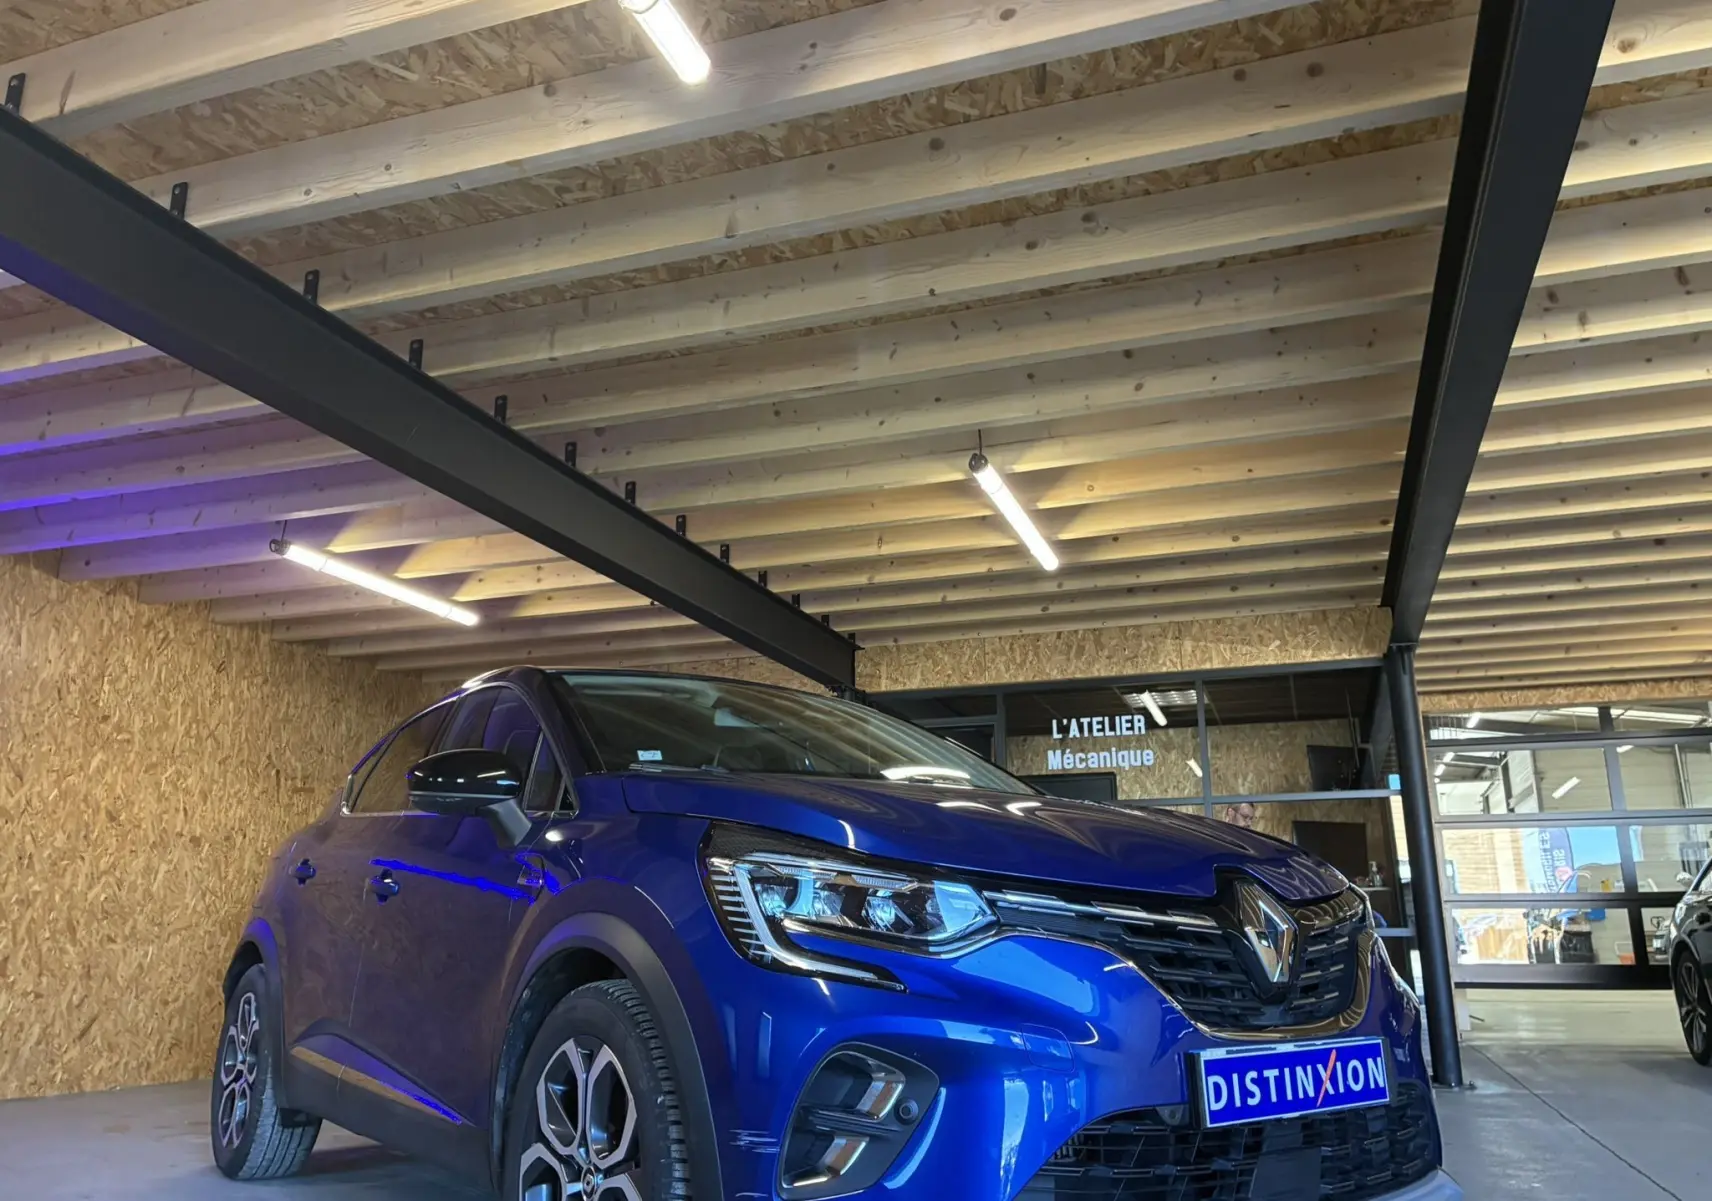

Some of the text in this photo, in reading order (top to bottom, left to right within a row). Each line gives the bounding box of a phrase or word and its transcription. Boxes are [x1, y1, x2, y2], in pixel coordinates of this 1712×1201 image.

[1052, 714, 1146, 739] L'ATELIER
[1047, 746, 1154, 771] Mécanique
[1207, 1049, 1385, 1111] DISTINXION
